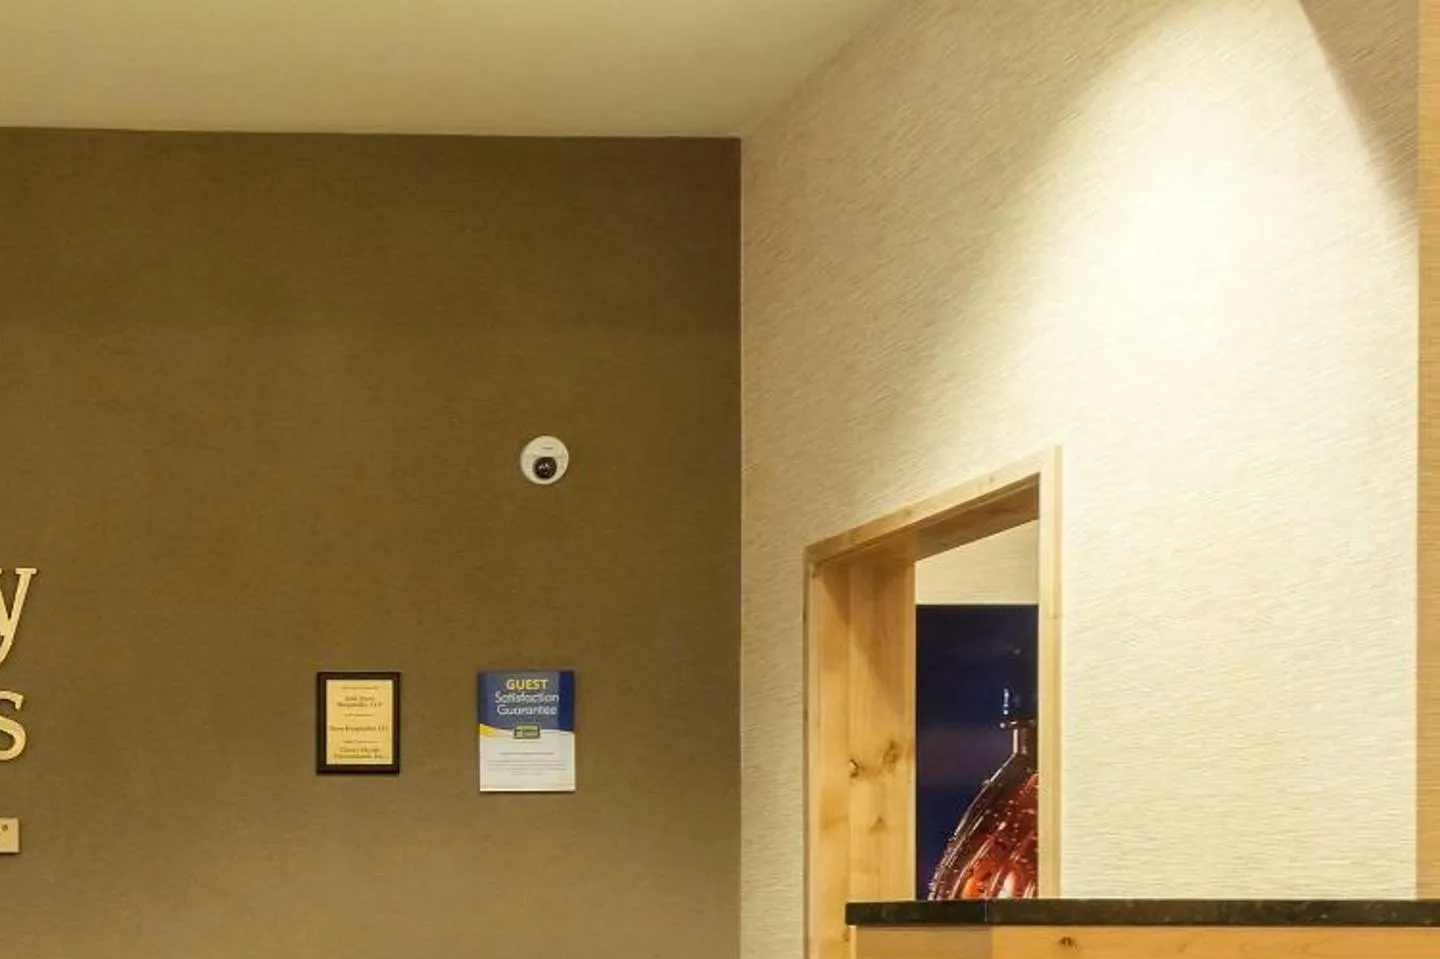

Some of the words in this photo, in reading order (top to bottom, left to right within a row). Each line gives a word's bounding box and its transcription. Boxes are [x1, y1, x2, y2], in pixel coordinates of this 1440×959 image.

[505, 678, 549, 690] GUEST
[494, 691, 559, 703] Satisfaction
[496, 704, 558, 715] Guarantee
